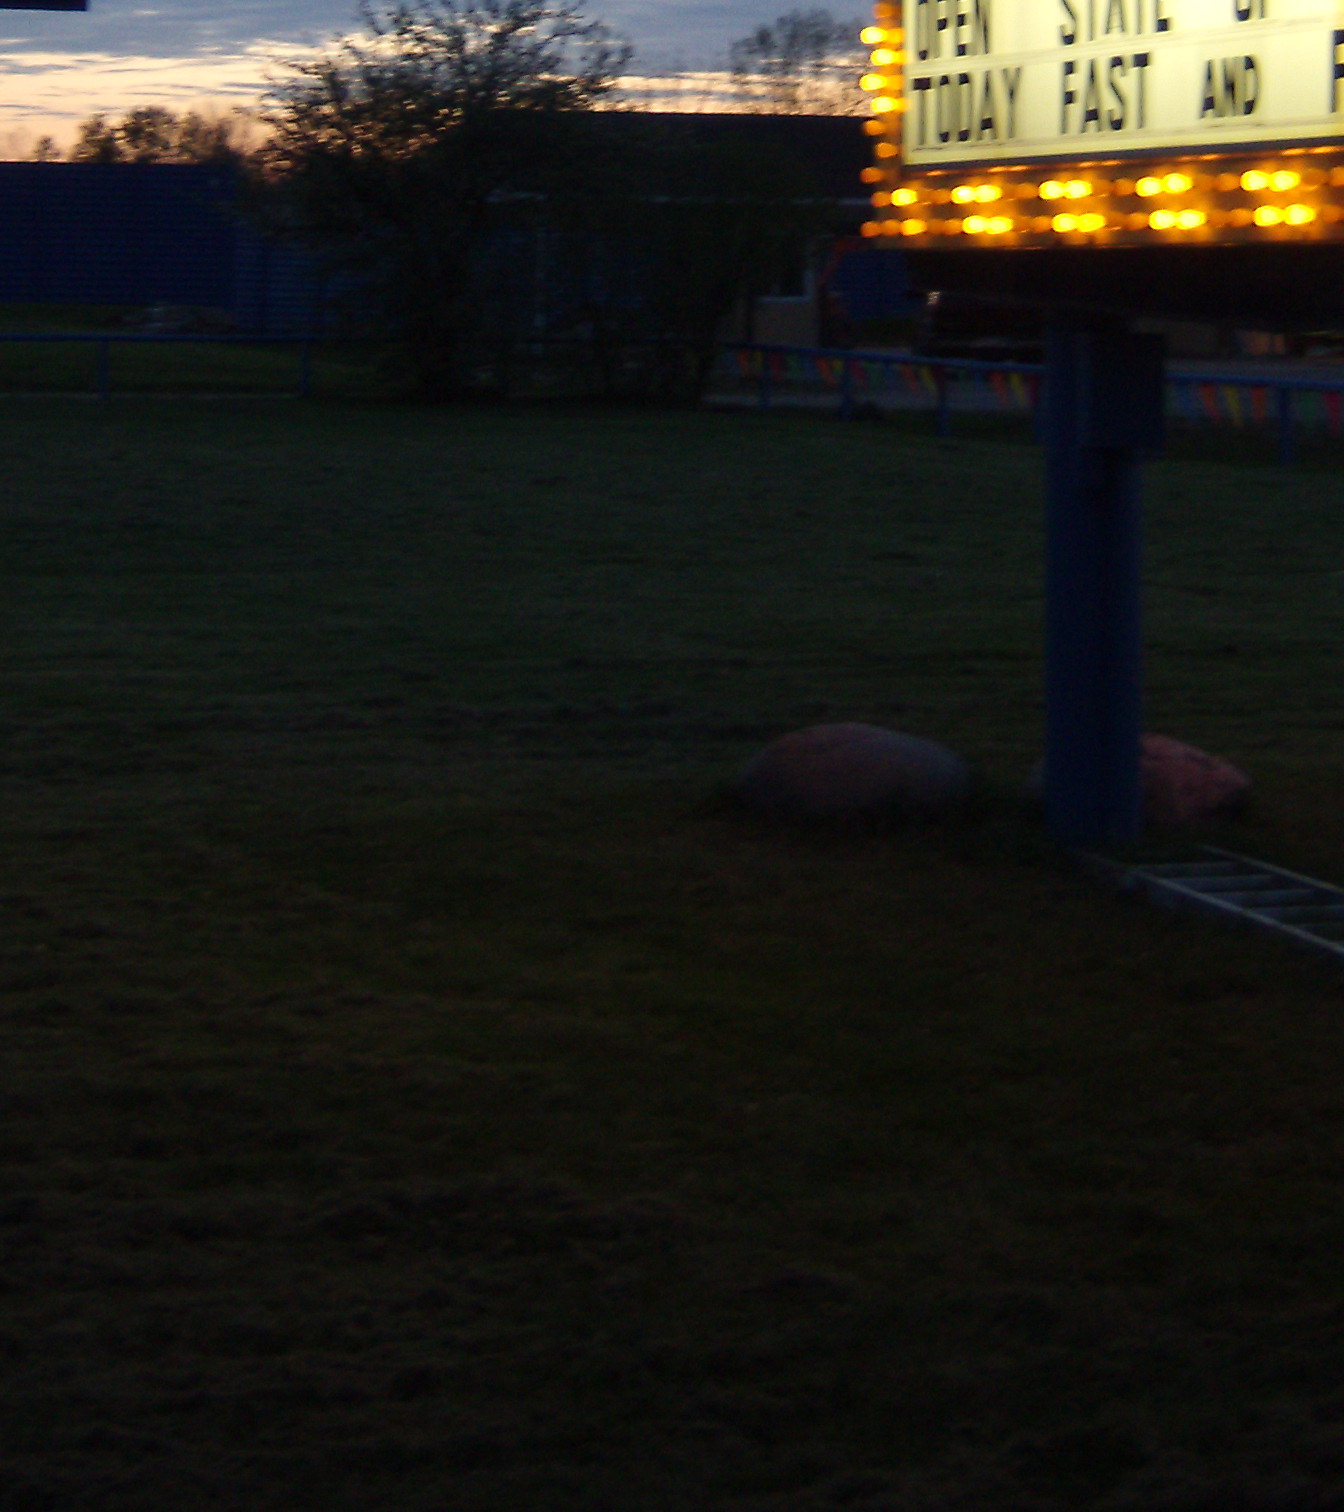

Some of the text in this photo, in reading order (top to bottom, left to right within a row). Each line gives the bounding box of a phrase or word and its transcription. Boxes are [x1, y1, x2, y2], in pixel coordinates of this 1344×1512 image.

[911, 65, 1022, 146] TODAY
[1060, 51, 1152, 135] FAST
[1199, 54, 1261, 120] AND
